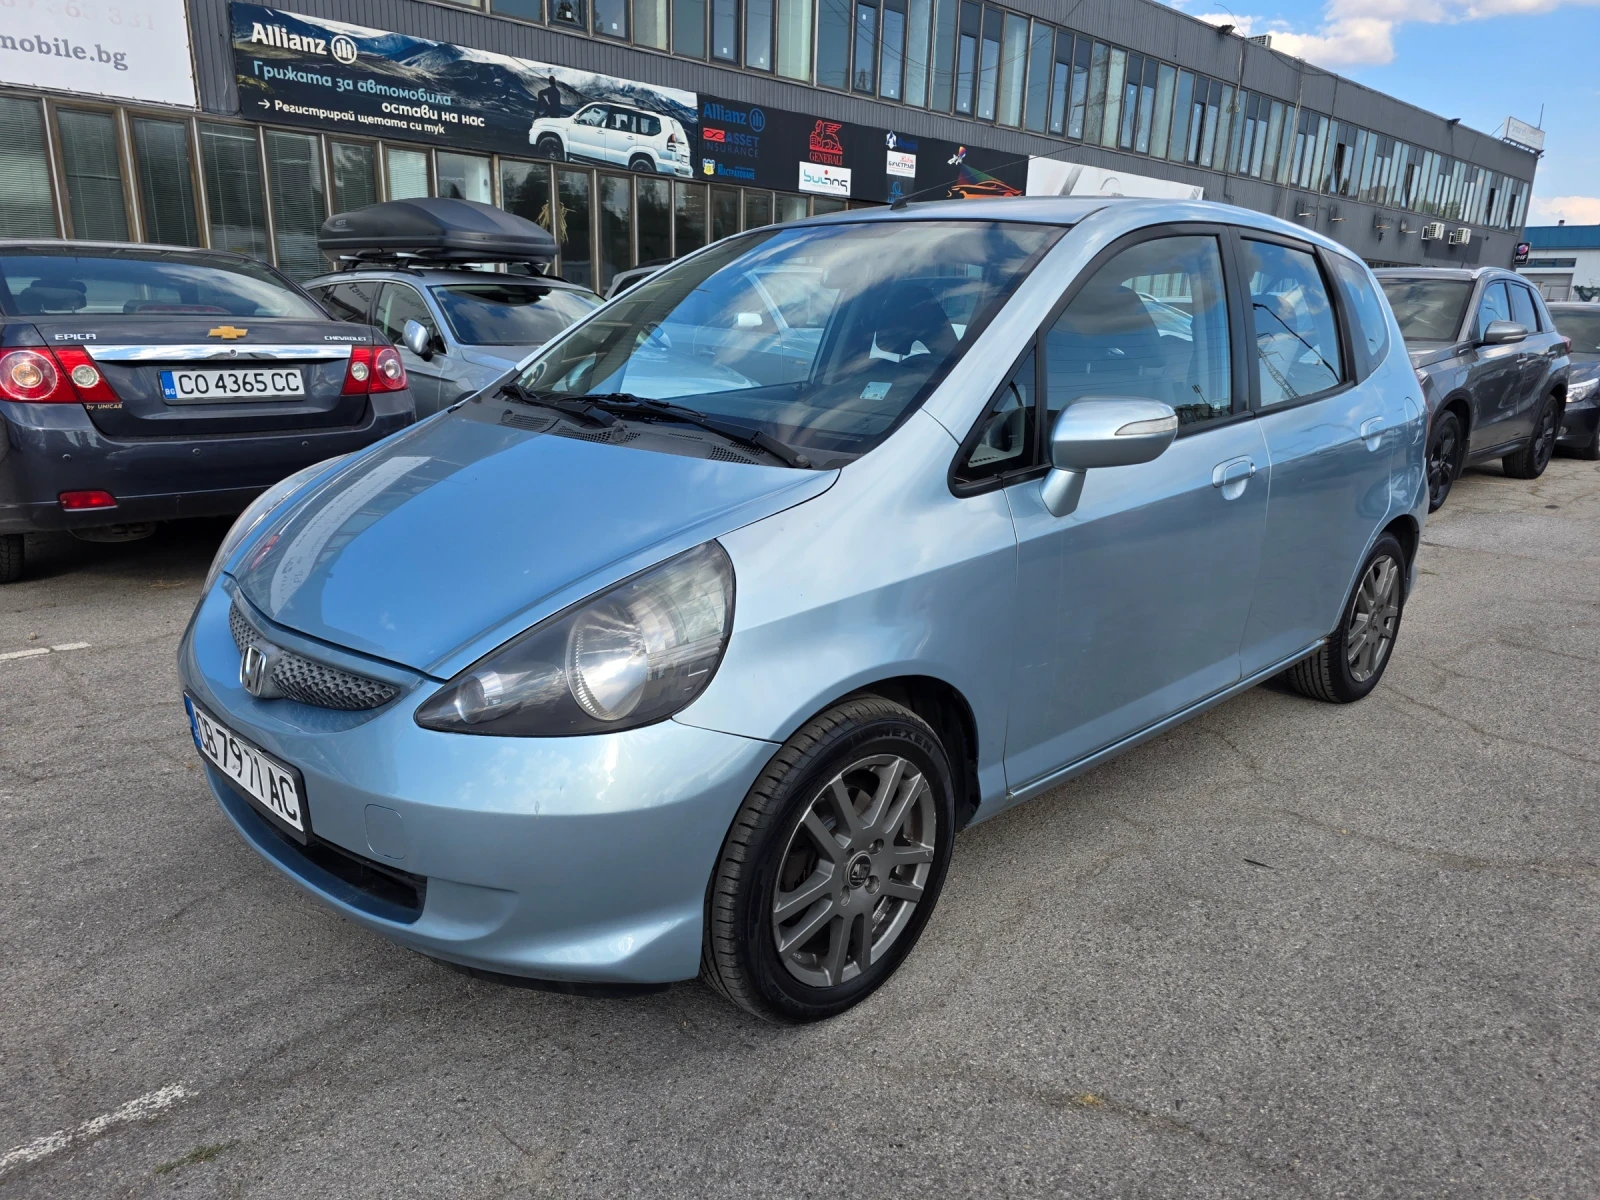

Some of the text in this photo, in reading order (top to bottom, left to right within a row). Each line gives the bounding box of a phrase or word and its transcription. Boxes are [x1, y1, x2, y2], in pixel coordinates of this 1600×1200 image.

[251, 22, 328, 56] Allianz
[253, 60, 452, 106] Грижата за автомобила
[274, 100, 446, 135] Регистрирай щетата си тук
[382, 101, 486, 127] остави на нас
[703, 102, 747, 125] Allianz
[703, 141, 760, 158] INSURANCE
[725, 132, 760, 148] ASSET
[809, 151, 843, 166] GENERALI
[54, 333, 97, 341] EPICA
[164, 387, 176, 395] BG
[178, 372, 300, 395] CO 4365 CC
[878, 727, 933, 754] NEXEN
[268, 766, 298, 821] AC
